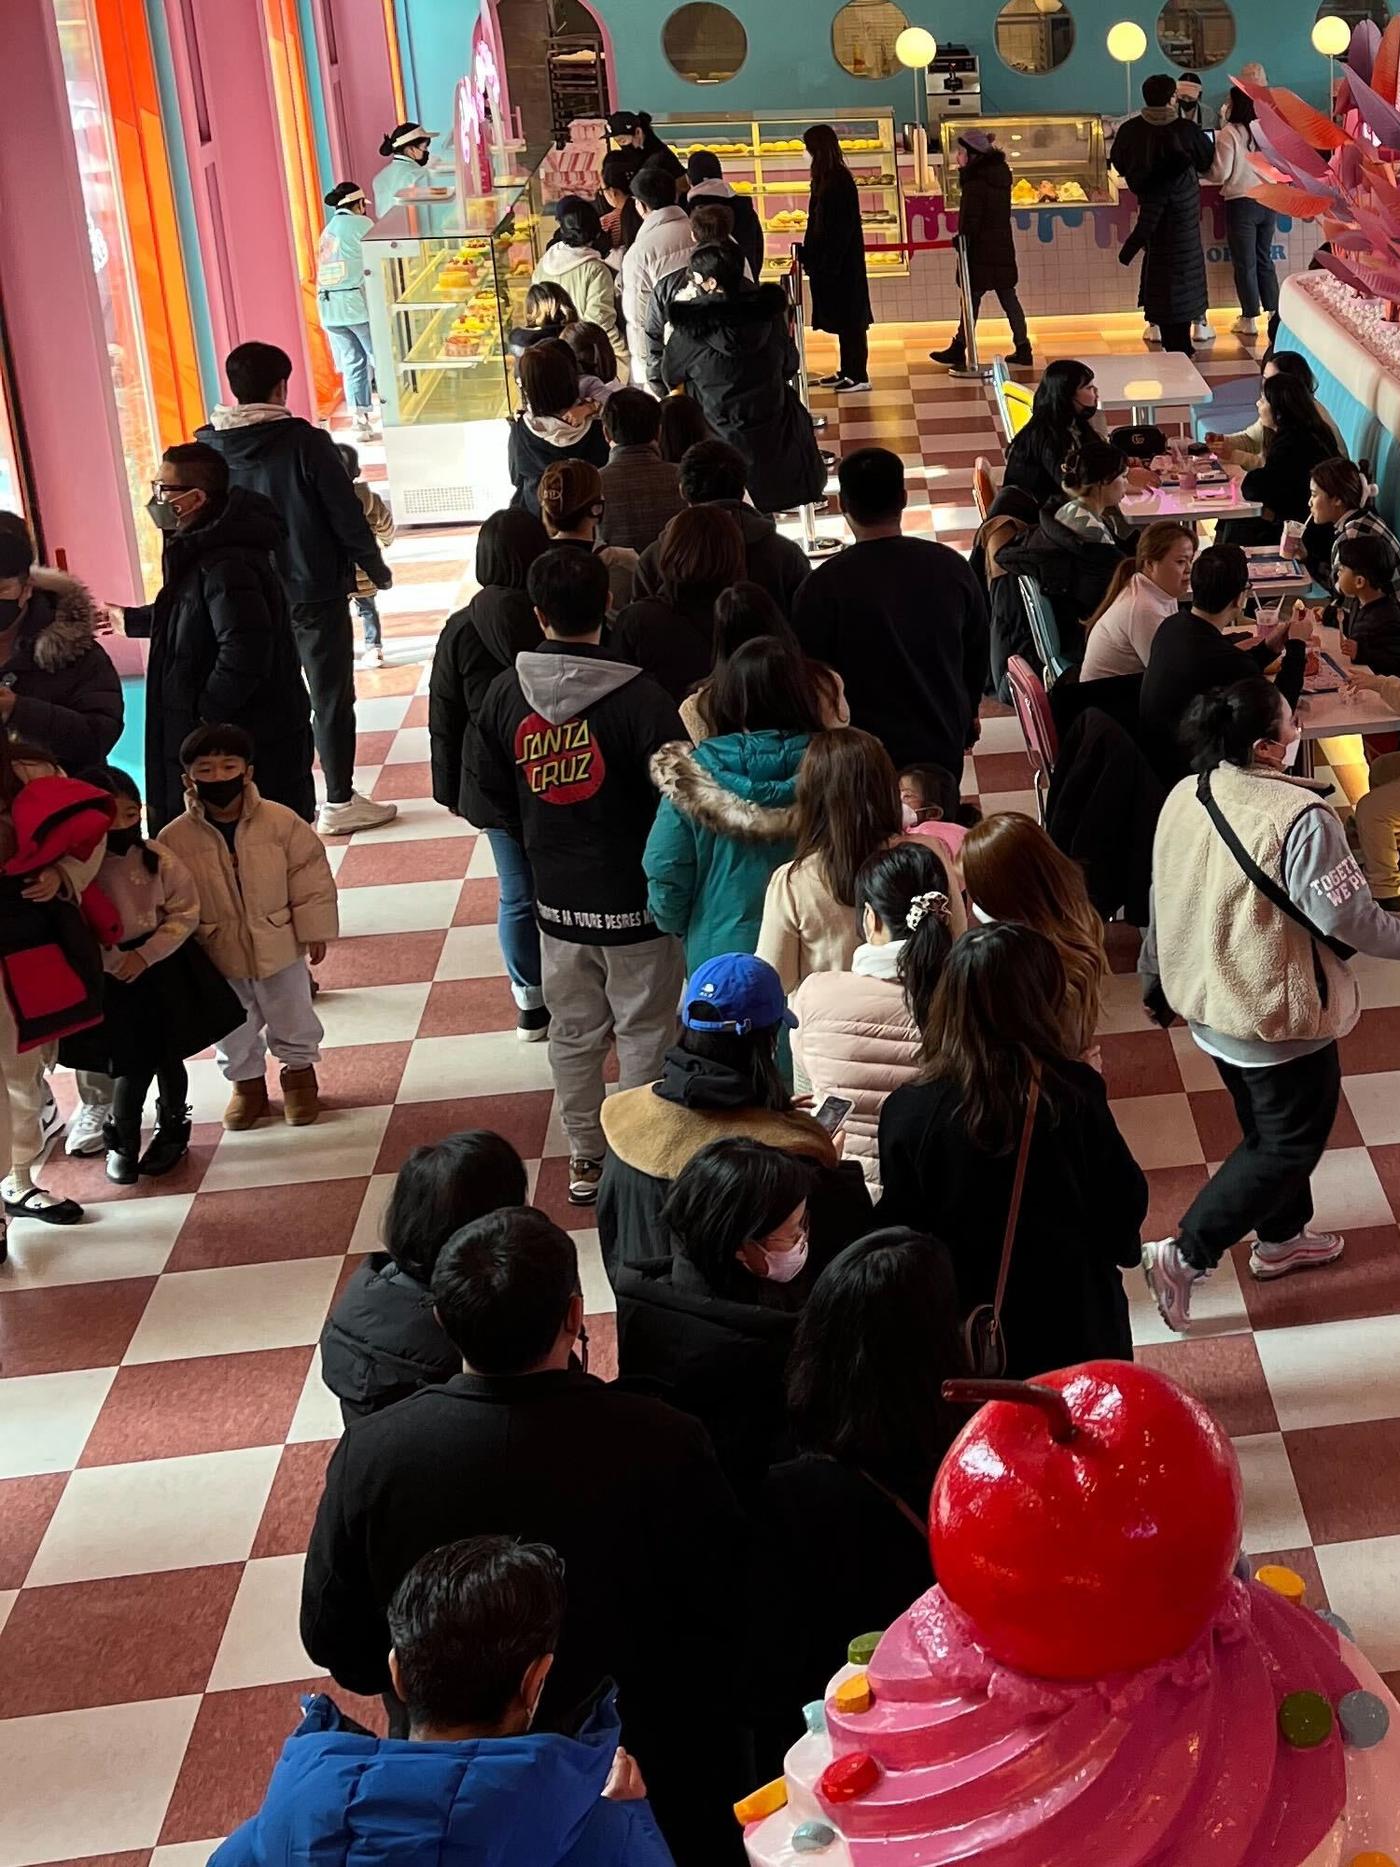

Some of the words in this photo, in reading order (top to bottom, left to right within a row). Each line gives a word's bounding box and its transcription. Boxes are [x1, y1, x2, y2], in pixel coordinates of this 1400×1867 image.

[514, 719, 590, 765] SANTA
[530, 752, 592, 793] CRUZ
[1326, 882, 1351, 907] WE
